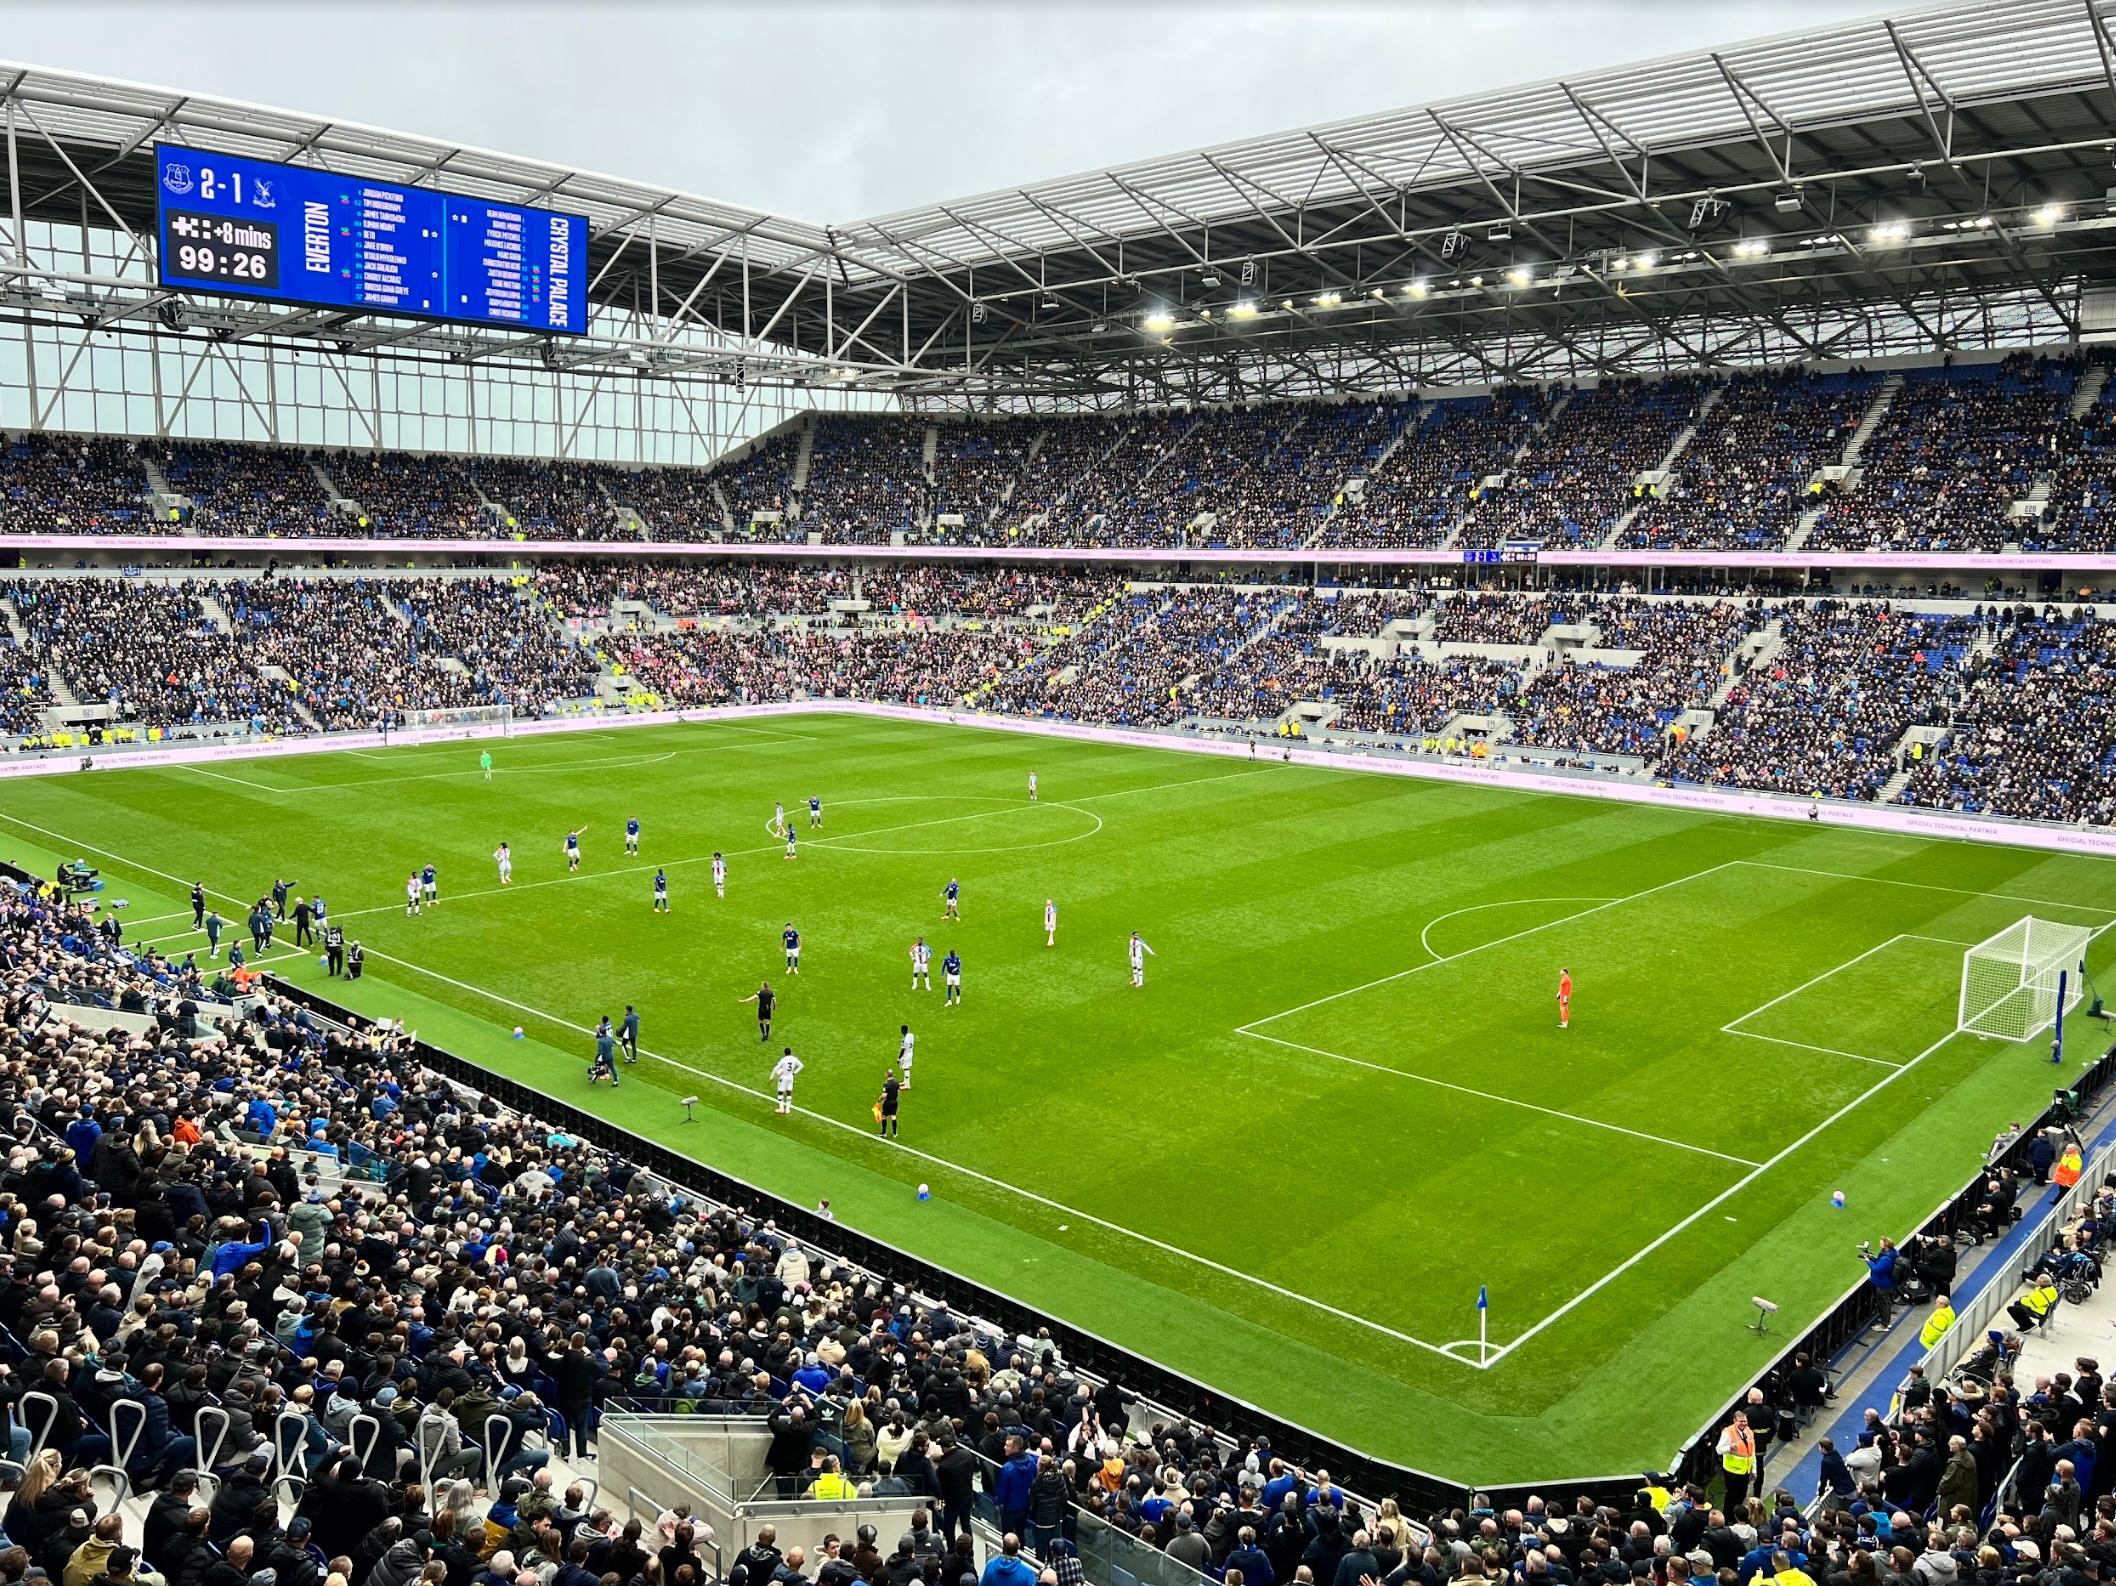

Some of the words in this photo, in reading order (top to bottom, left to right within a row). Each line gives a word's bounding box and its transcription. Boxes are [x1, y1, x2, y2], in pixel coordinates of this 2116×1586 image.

[214, 221, 233, 245] +8
[234, 225, 272, 250] mins
[304, 201, 331, 273] EVERTON
[549, 217, 569, 275] CRYSTAL
[179, 245, 267, 279] 99:26
[549, 278, 569, 327] PALACE
[786, 1062, 792, 1072] 3
